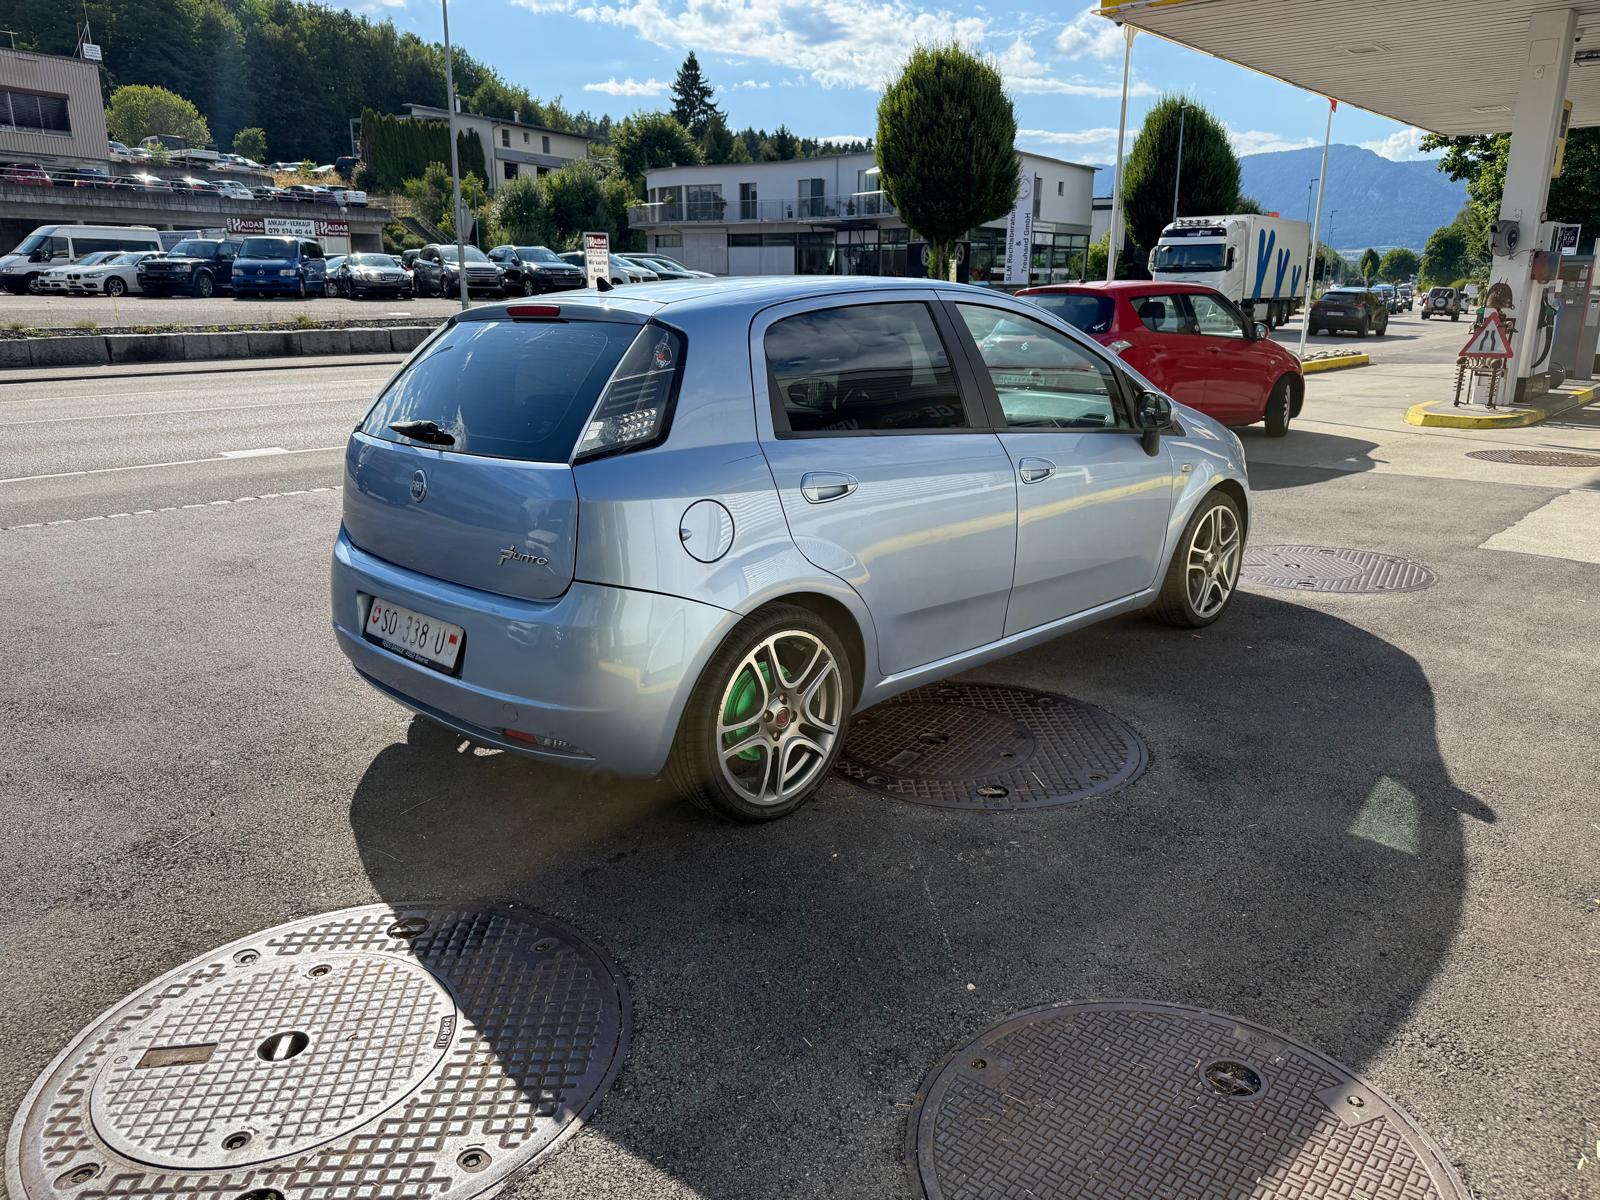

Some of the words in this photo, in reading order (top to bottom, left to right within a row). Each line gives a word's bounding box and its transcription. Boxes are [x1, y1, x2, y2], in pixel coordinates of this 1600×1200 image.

[1023, 212, 1031, 236] GmbH
[1021, 238, 1029, 273] Treuhand
[381, 609, 398, 635] SO
[402, 616, 430, 648] 338
[434, 627, 447, 655] U
